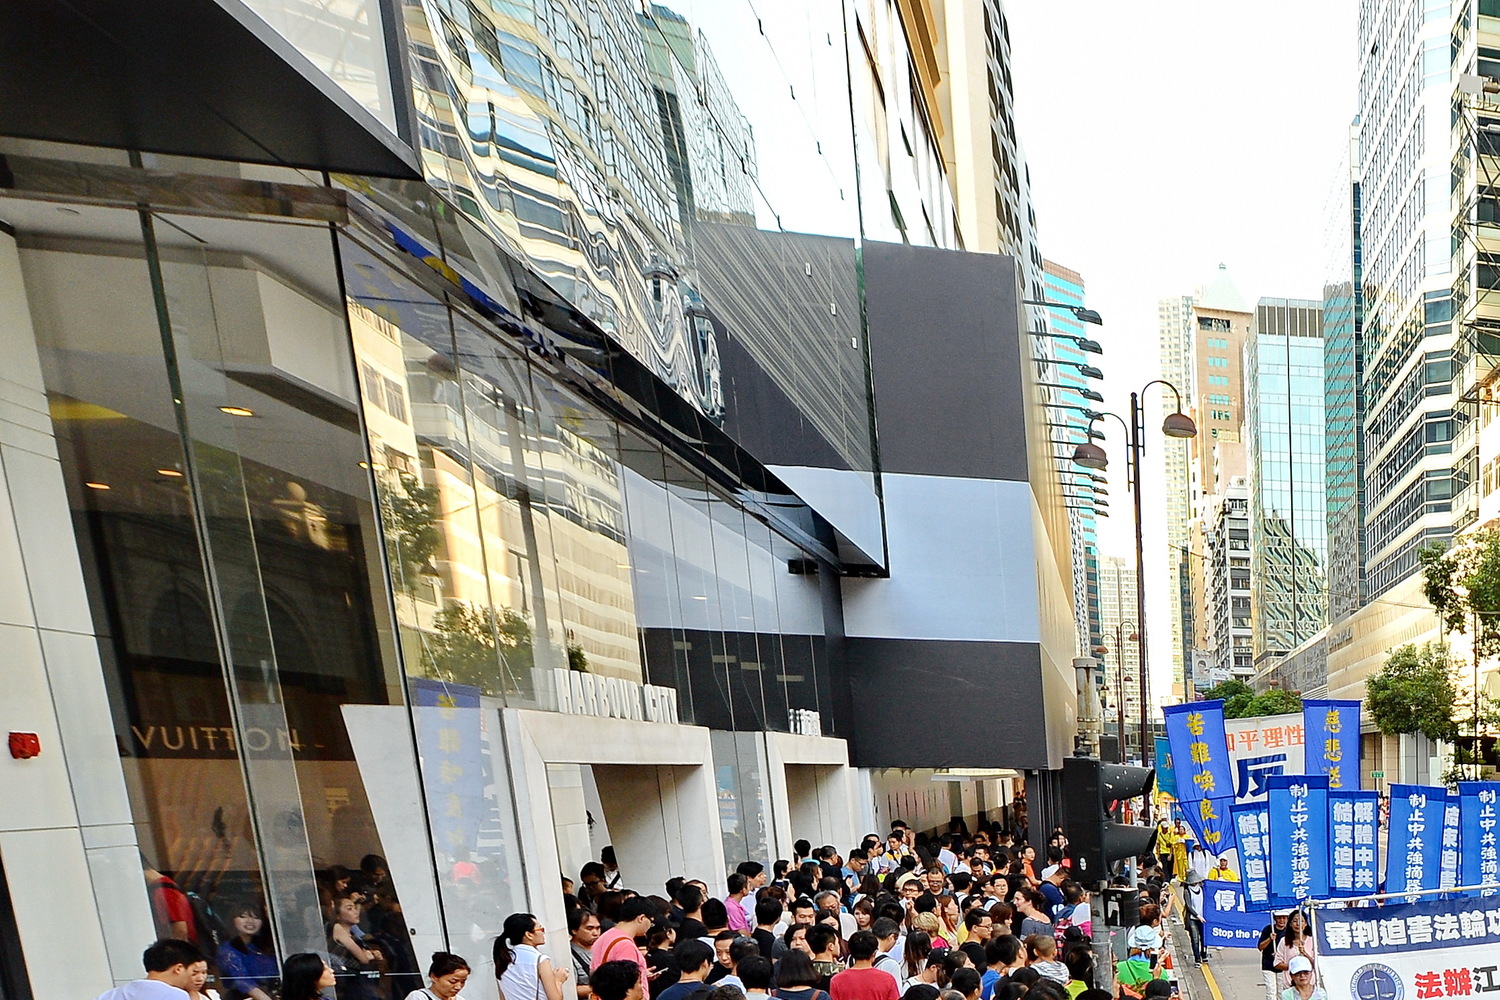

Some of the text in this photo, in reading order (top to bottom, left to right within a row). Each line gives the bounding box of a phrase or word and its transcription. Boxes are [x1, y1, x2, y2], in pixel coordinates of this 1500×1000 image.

[554, 667, 643, 721] HARBOUR
[130, 725, 301, 752] VUITTON
[1238, 813, 1268, 902] 結束迫害
[1289, 783, 1312, 900] 制止中共強摘器官
[1333, 801, 1353, 888] 結束迫害
[1353, 801, 1374, 889] 解體中共
[1212, 927, 1234, 939] Stop
[1235, 929, 1250, 938] the
